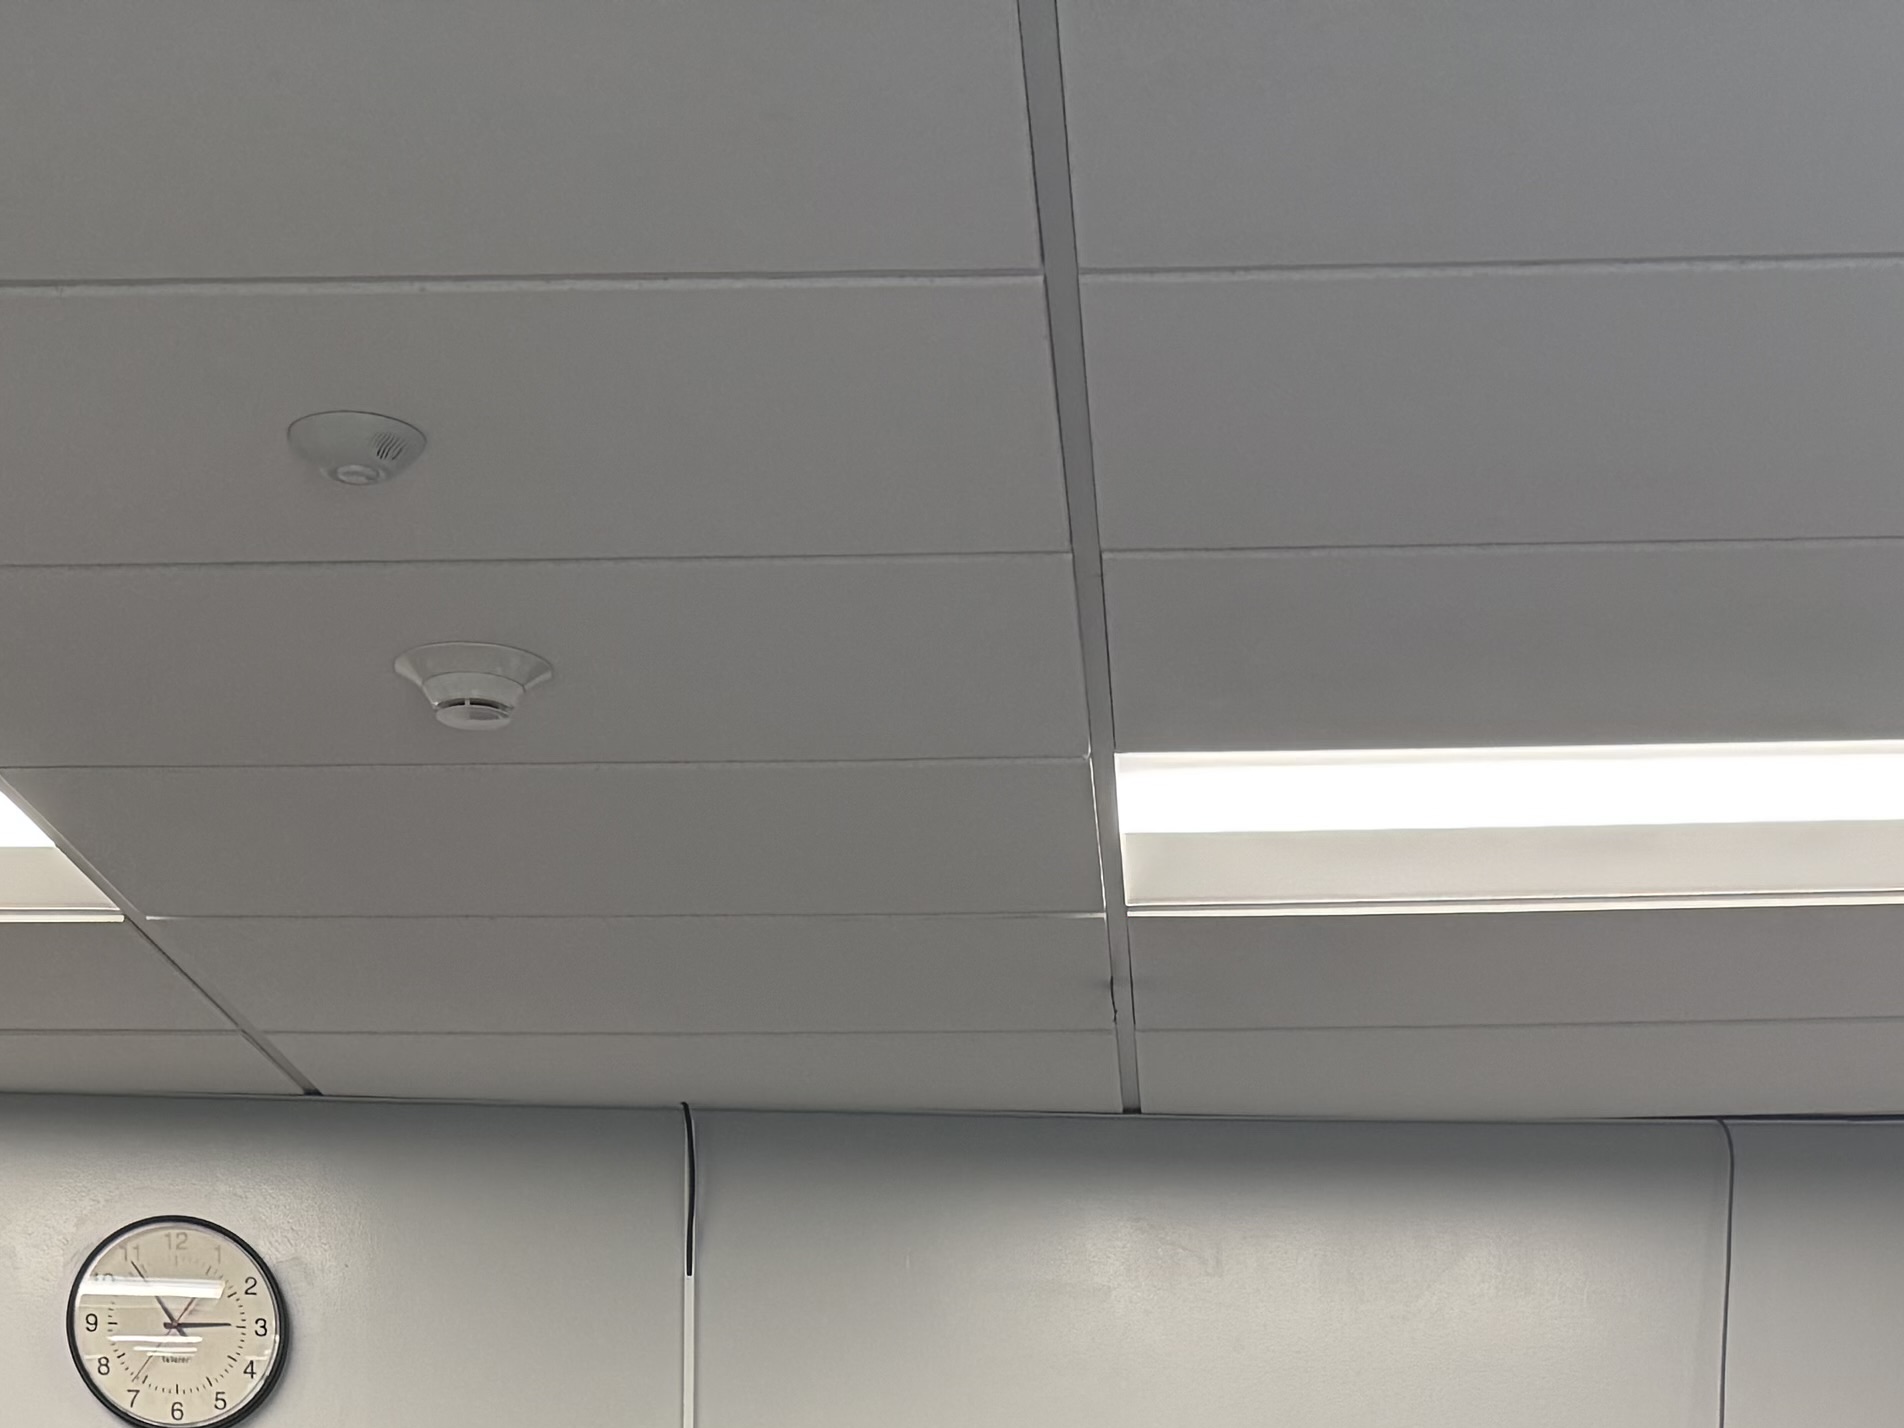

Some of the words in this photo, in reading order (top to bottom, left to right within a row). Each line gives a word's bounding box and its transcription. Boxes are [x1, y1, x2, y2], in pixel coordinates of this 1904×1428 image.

[164, 1232, 188, 1250] 12
[118, 1243, 140, 1261] 11
[244, 1276, 257, 1295] 2
[85, 1313, 98, 1332] 9
[254, 1318, 267, 1337] 3
[97, 1356, 110, 1375] 8
[243, 1360, 256, 1379] 4
[127, 1389, 140, 1408] 7
[214, 1391, 227, 1410] 5
[171, 1402, 184, 1420] 6
